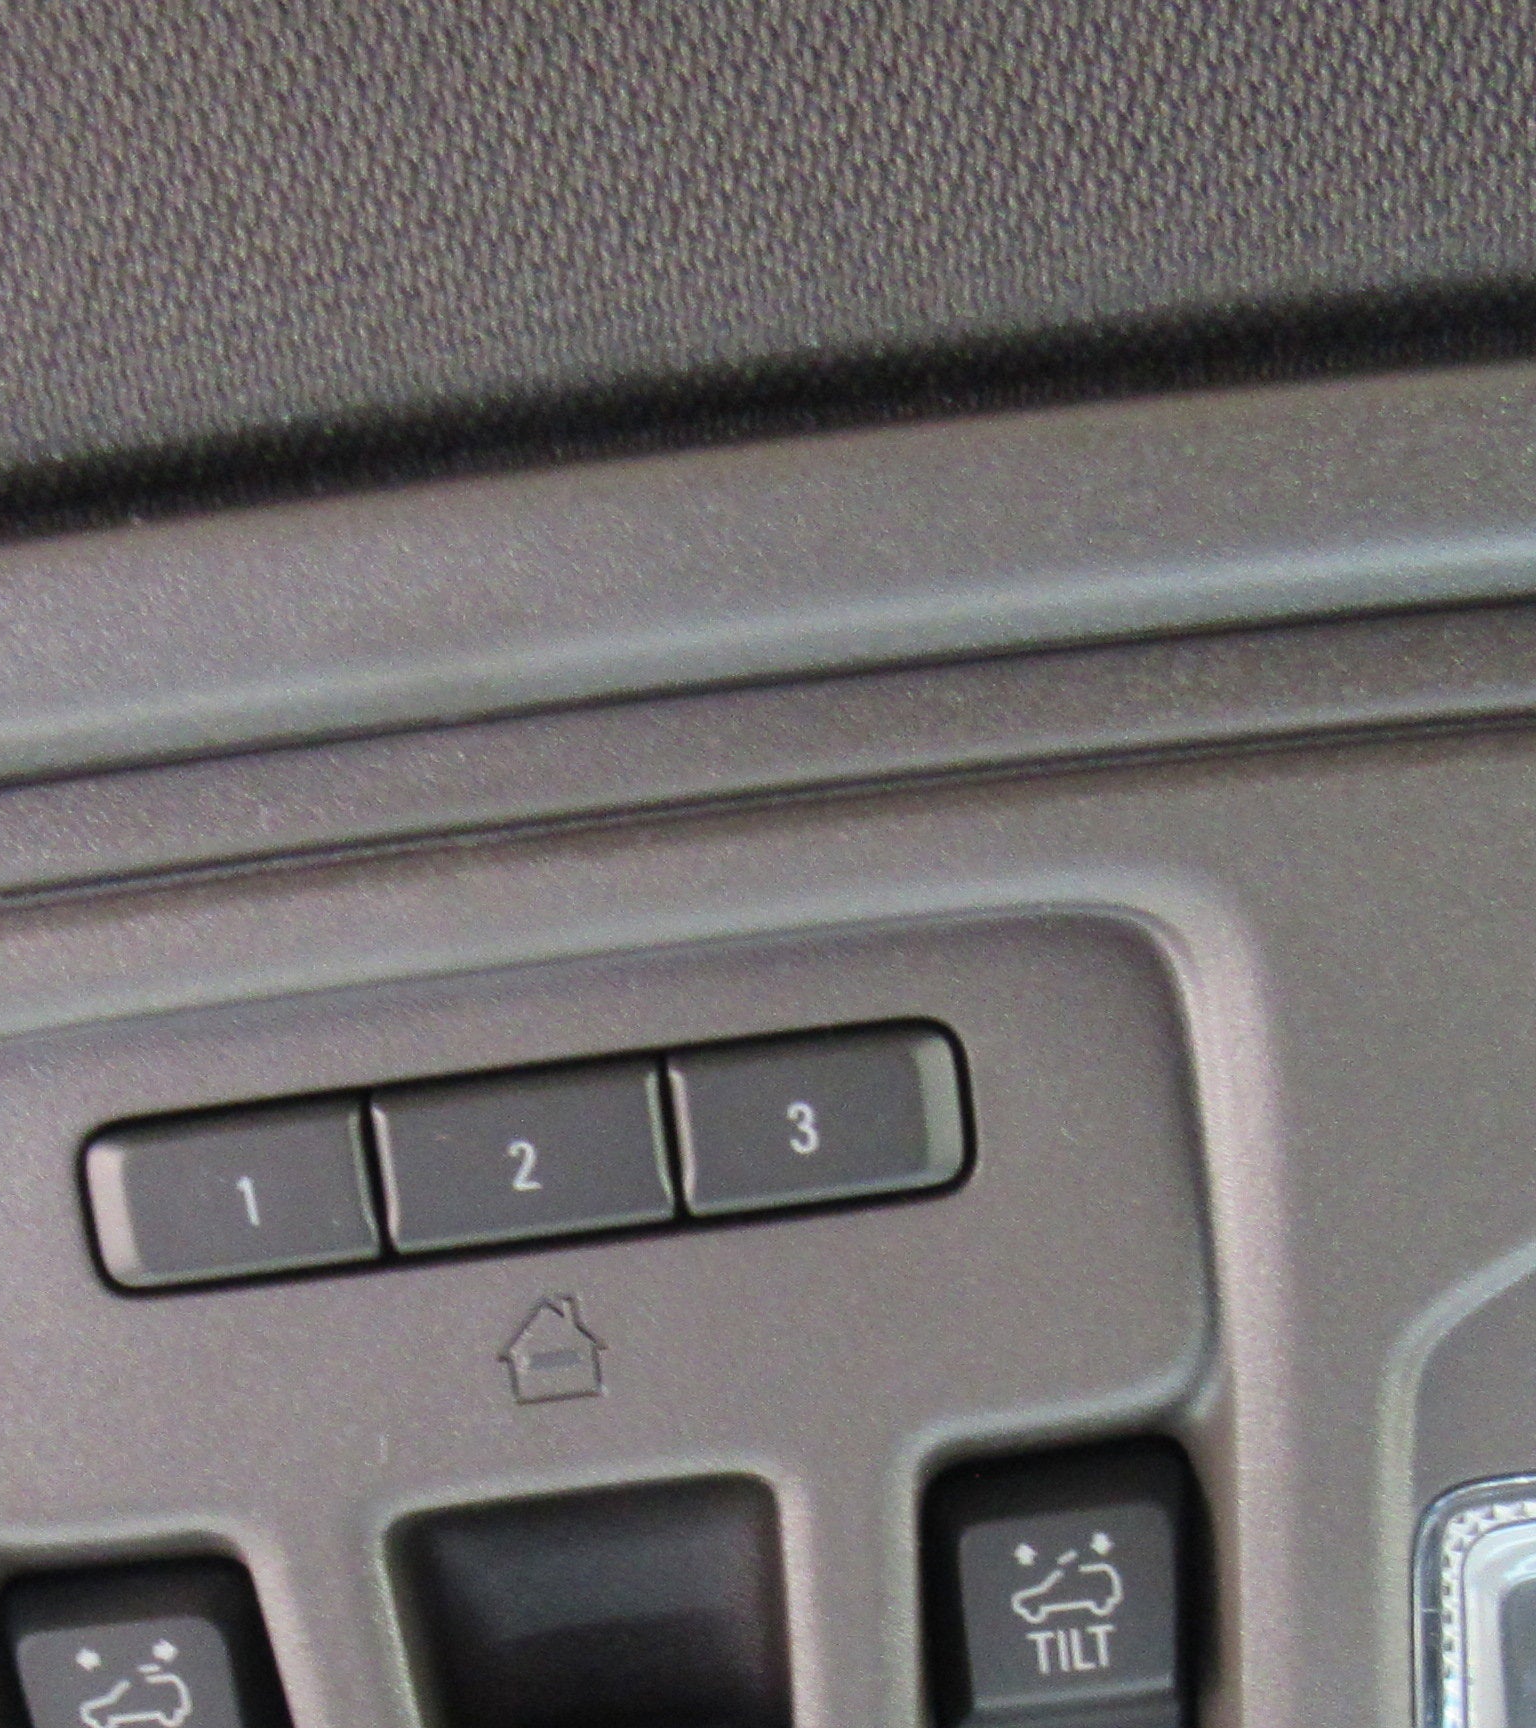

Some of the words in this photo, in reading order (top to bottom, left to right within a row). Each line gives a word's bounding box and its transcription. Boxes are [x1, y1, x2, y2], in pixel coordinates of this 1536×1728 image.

[785, 1101, 820, 1155] 3
[506, 1139, 543, 1192] 2
[235, 1174, 262, 1227] 1
[1025, 1623, 1117, 1674] TILT
